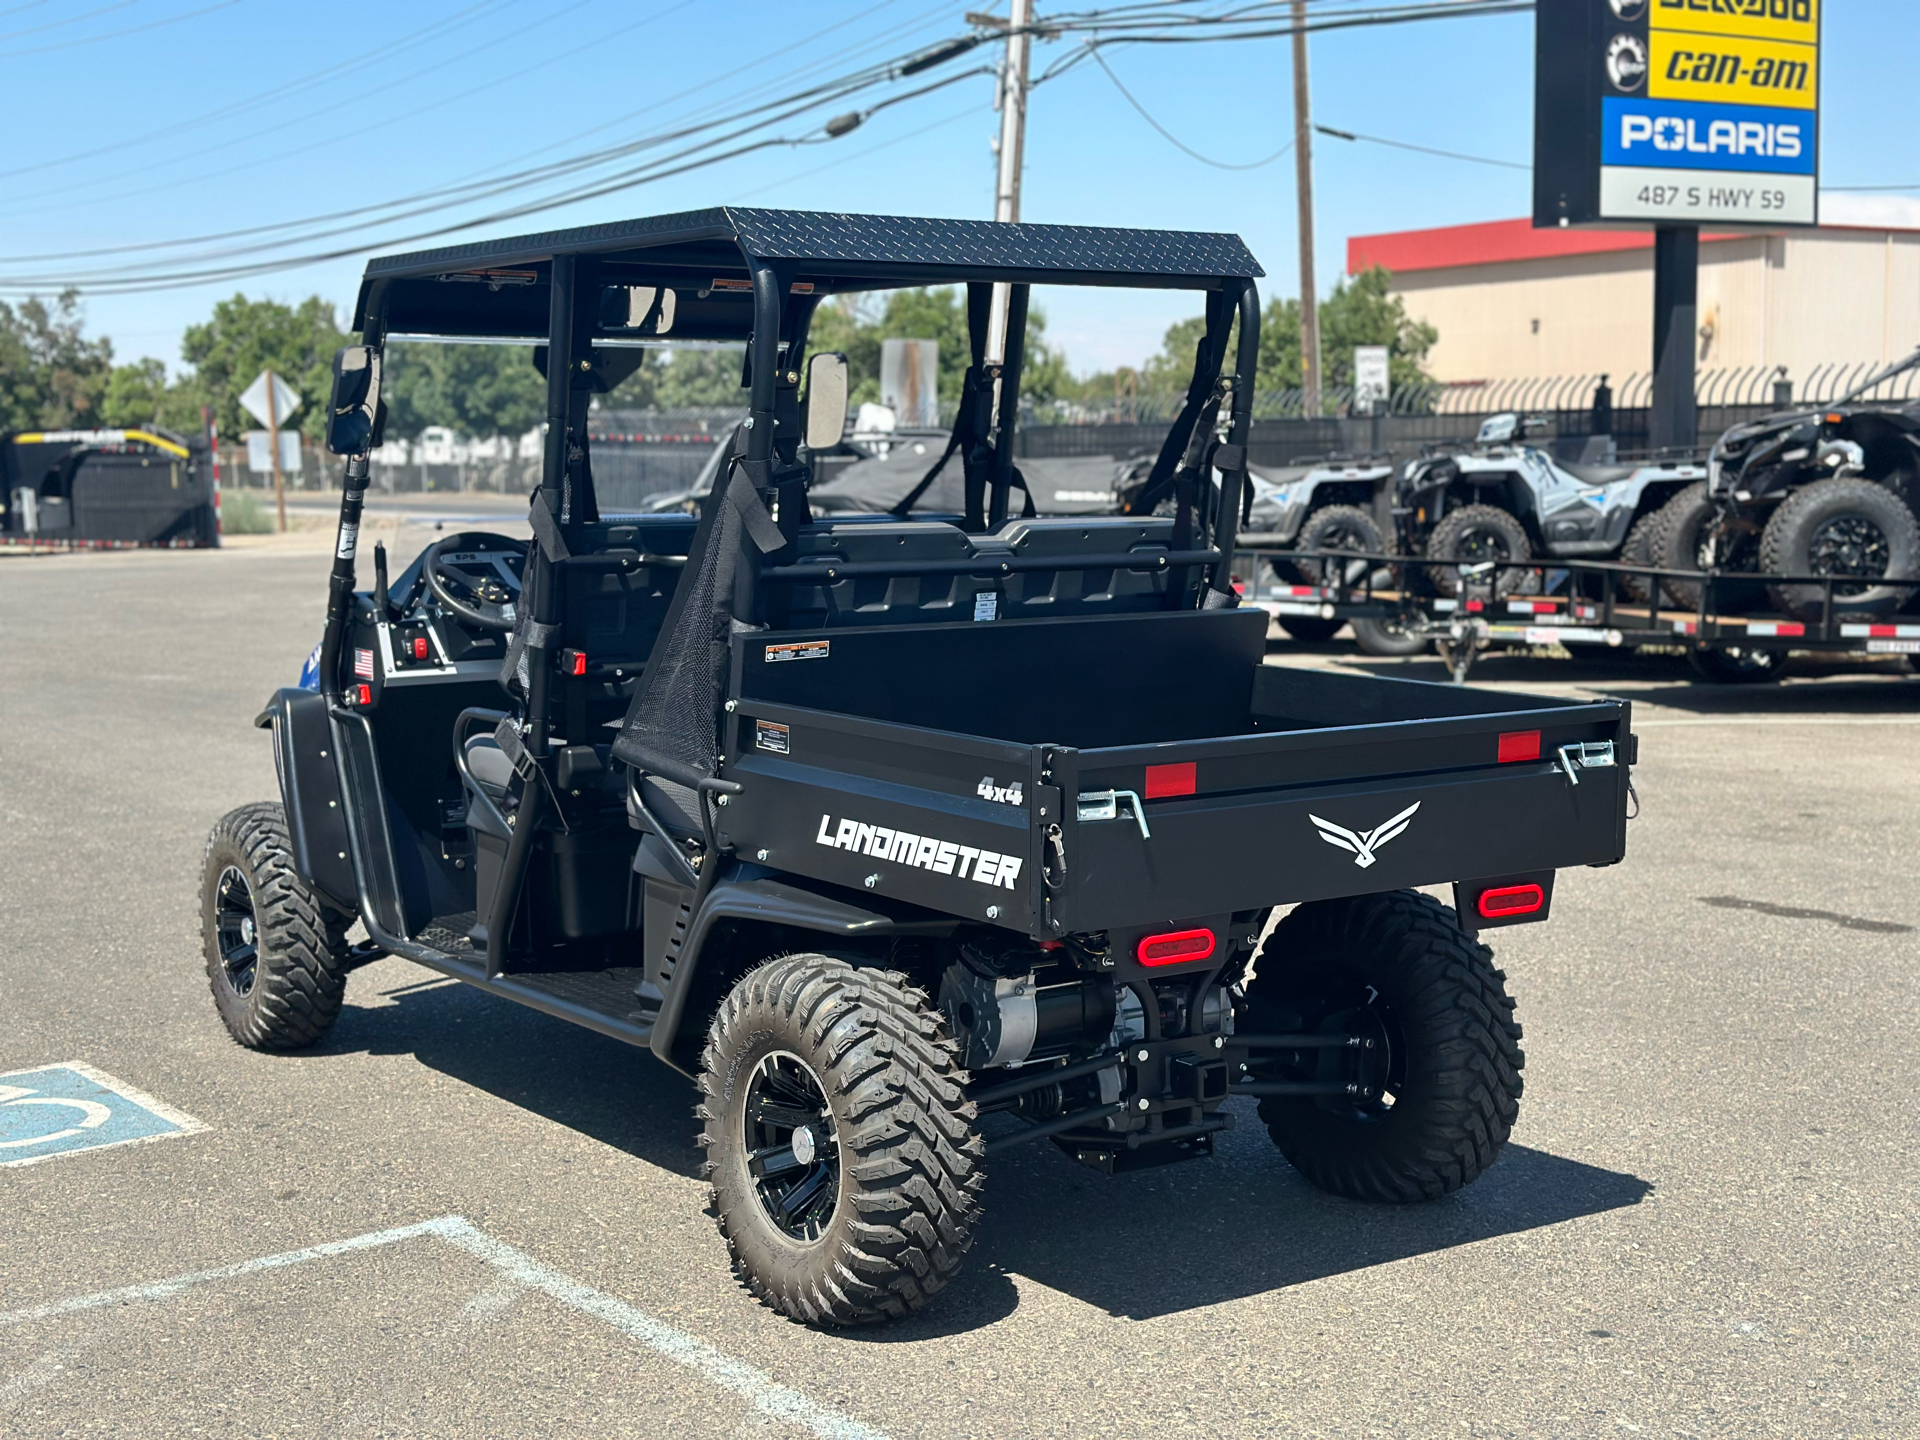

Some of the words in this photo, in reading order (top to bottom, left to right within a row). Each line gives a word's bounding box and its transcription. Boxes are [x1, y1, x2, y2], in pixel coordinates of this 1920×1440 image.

[1621, 114, 1801, 158] POLARIS
[1637, 185, 1679, 206] 487
[1687, 187, 1701, 206] S
[1708, 187, 1754, 208] HWY
[1761, 190, 1785, 209] 59
[455, 553, 477, 561] EPS
[977, 776, 1023, 806] 4x4
[816, 814, 1023, 890] LANDMASTER
